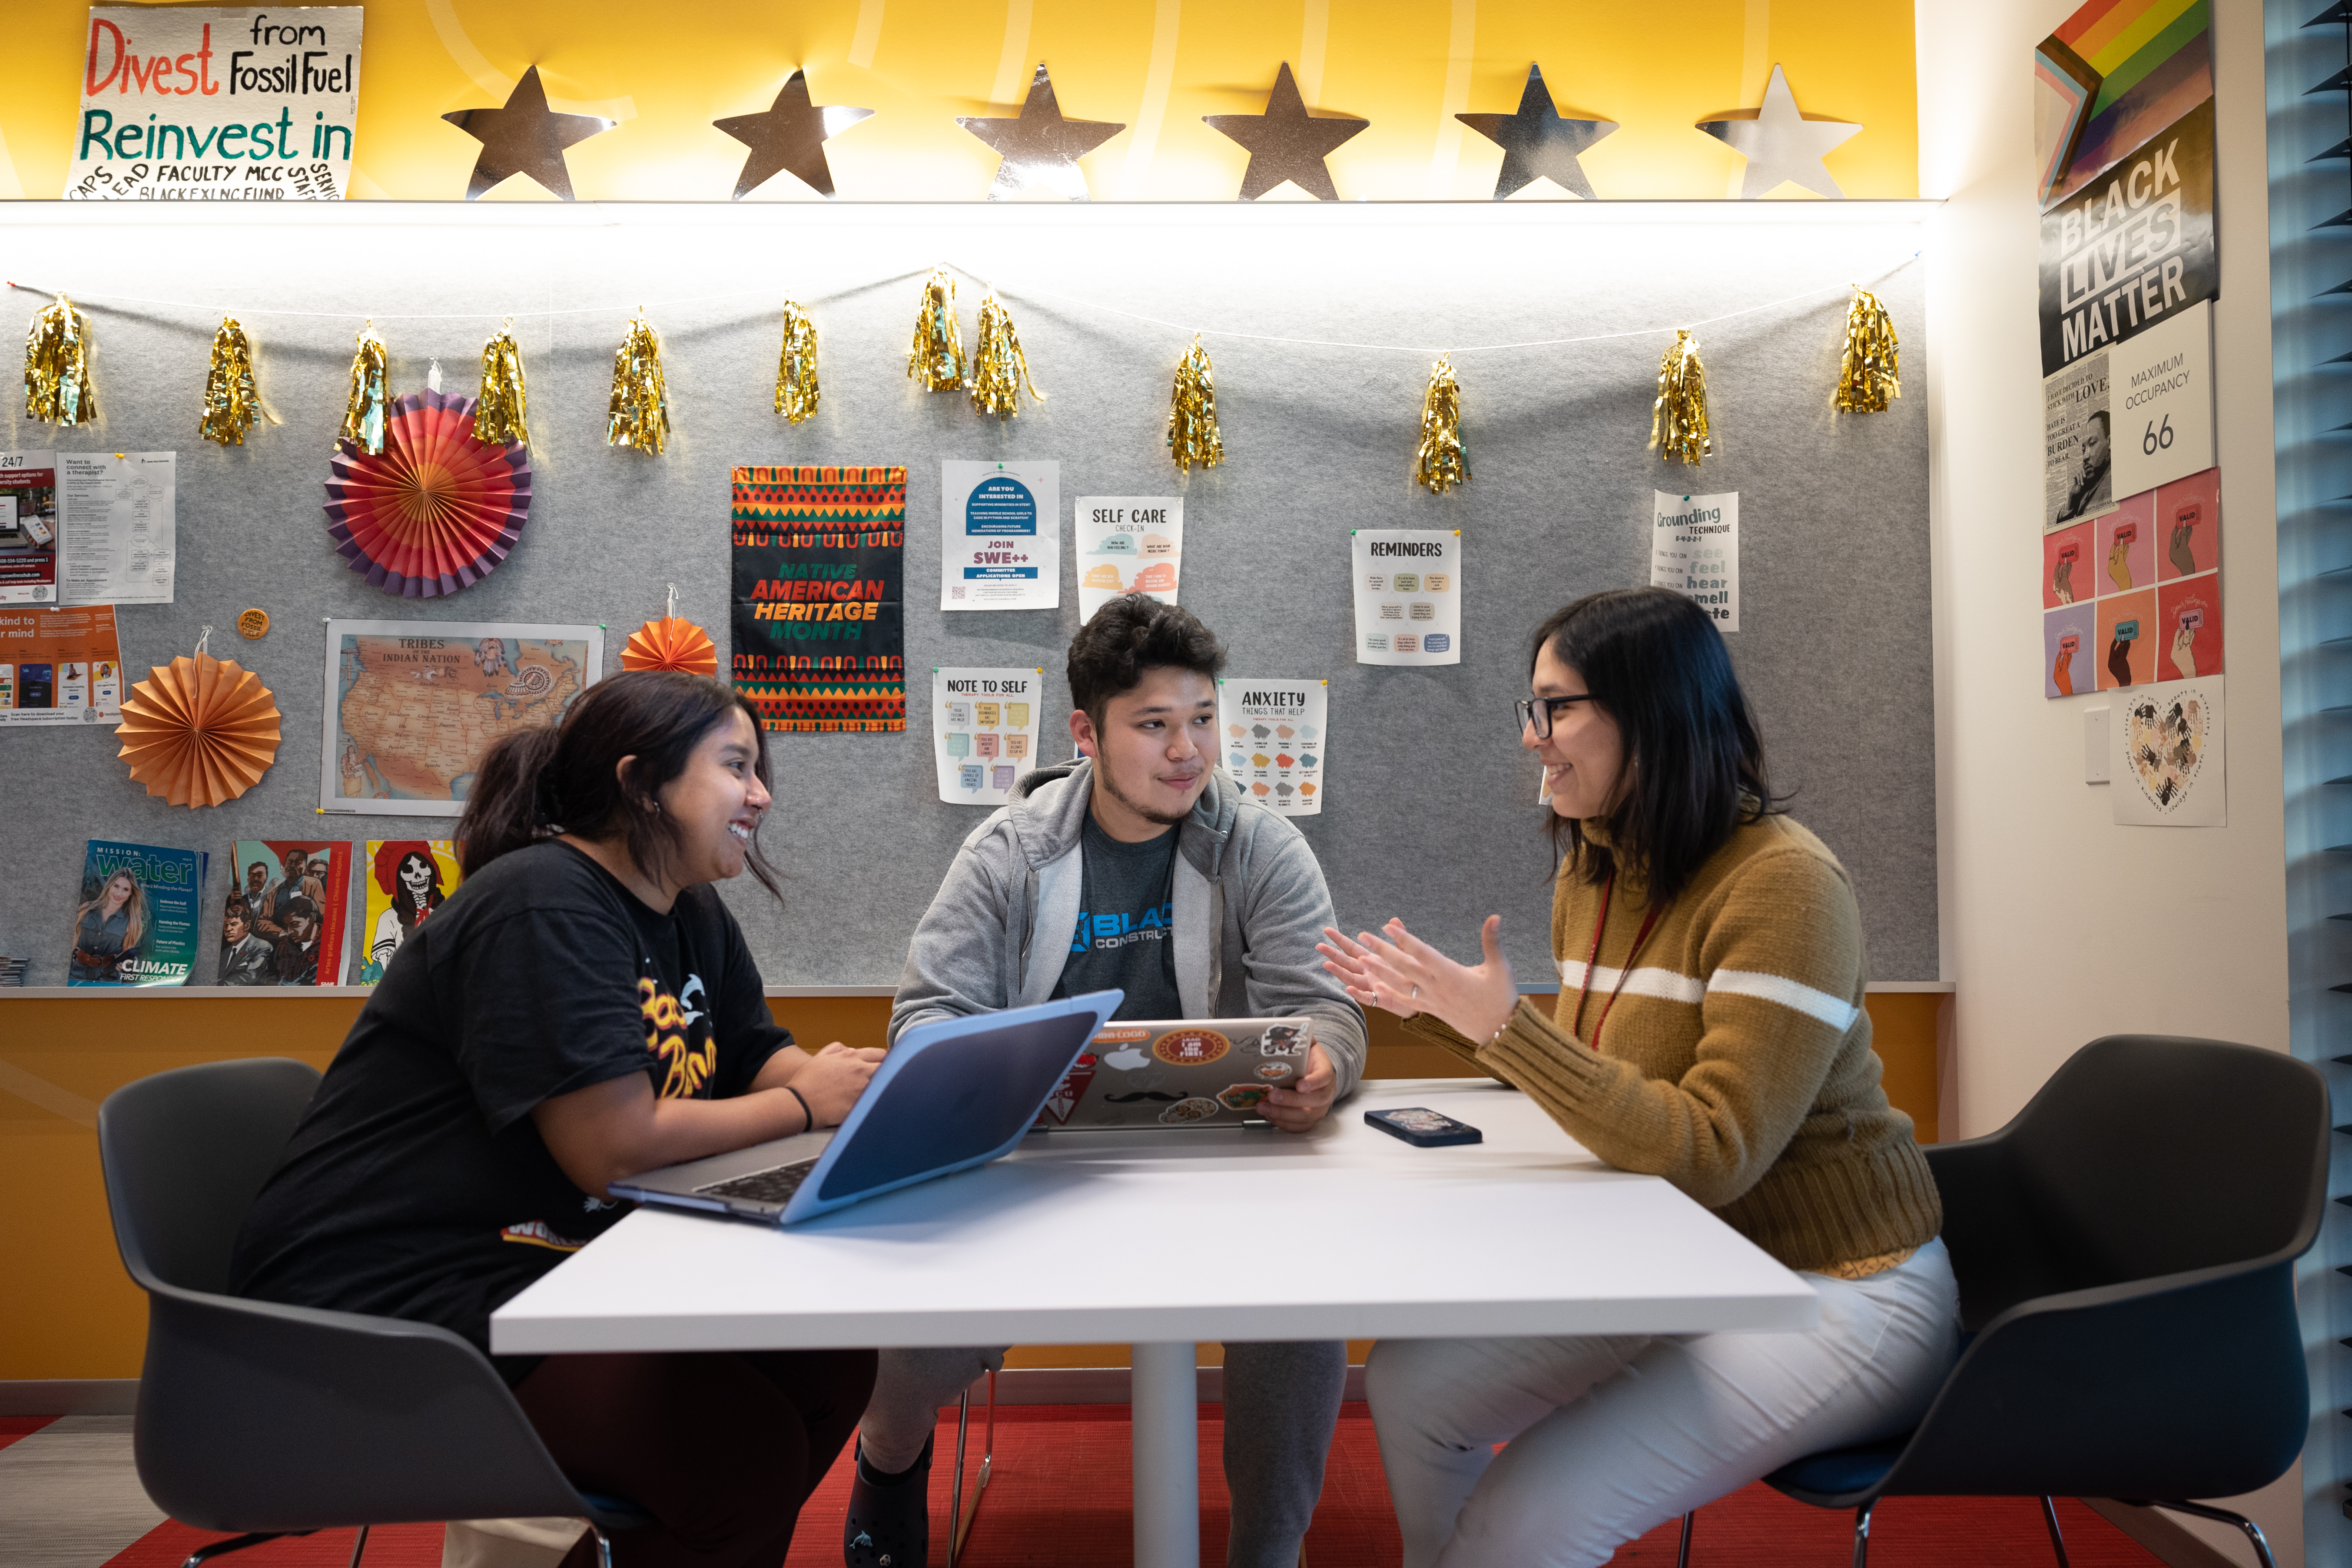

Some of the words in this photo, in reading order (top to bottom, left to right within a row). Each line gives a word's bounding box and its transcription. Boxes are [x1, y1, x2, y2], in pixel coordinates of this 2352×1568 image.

[250, 14, 325, 46] from
[86, 18, 219, 96] Divest
[230, 51, 296, 95] Fossil
[302, 51, 352, 95] Fuel
[80, 106, 299, 160] Reinvest
[312, 111, 352, 160] in
[102, 163, 149, 199] EAD
[157, 165, 236, 182] FACULTY
[245, 166, 283, 181] MCC
[140, 187, 186, 199] BLACK
[2061, 138, 2180, 258] BLACK
[2067, 202, 2175, 305] LIVES
[2062, 255, 2186, 362] MATTER
[2131, 353, 2183, 388] MAXIMUM
[2048, 399, 2061, 411] STICK
[2062, 392, 2074, 403] WITH
[2076, 378, 2110, 403] LOVE.
[2050, 389, 2062, 401] HAVE
[2063, 378, 2084, 394] DECIDED
[2086, 373, 2093, 381] TO
[2126, 370, 2190, 410] OCCUPANCY
[2047, 419, 2060, 431] HATE
[2047, 432, 2057, 442] TOO
[2058, 423, 2075, 437] GREAT
[2143, 414, 2174, 455] 66
[2047, 434, 2079, 456] BURDEN
[2, 457, 23, 467] 24/7
[2055, 453, 2070, 465] BEAR.
[1093, 509, 1124, 523] SELF
[1131, 509, 1166, 523] CARE
[1657, 507, 1721, 527] Grounding
[2179, 512, 2195, 521] VALID
[1689, 524, 1730, 534] TECHNIQUE
[2117, 530, 2132, 539] VALID
[1371, 542, 1442, 557] REMINDERS
[1692, 548, 1723, 559] see
[2061, 550, 2075, 558] VALID
[974, 552, 1028, 564] SWE++
[778, 564, 857, 579] NATIVE
[1690, 560, 1725, 574] feel
[1687, 576, 1728, 589] hear
[750, 580, 884, 601] AMERICAN
[244, 612, 264, 620] DIVEST
[754, 602, 879, 620] HERITAGE
[0, 617, 20, 625] kind
[242, 622, 262, 631] FOSSIL
[245, 617, 262, 626] FROM
[2182, 615, 2198, 624] VALID
[8, 629, 34, 637] mind
[242, 628, 260, 636] FUELS
[770, 622, 863, 640] MONTH
[399, 639, 444, 649] TRIBES
[383, 653, 418, 662] INDIAN
[422, 655, 460, 663] NATION
[948, 680, 977, 692] NOTE
[982, 680, 997, 693] TO
[1002, 681, 1028, 693] SELF
[1242, 691, 1305, 706] ANXIETY
[2125, 698, 2136, 736] strength
[2148, 696, 2162, 710] unity
[2167, 690, 2187, 706] beauty
[2199, 693, 2211, 736] diversity
[2126, 751, 2135, 774] power
[2141, 786, 2162, 812] kindness
[97, 847, 141, 856] MISSION:
[96, 855, 192, 885] water
[122, 959, 188, 975] CLIMATE
